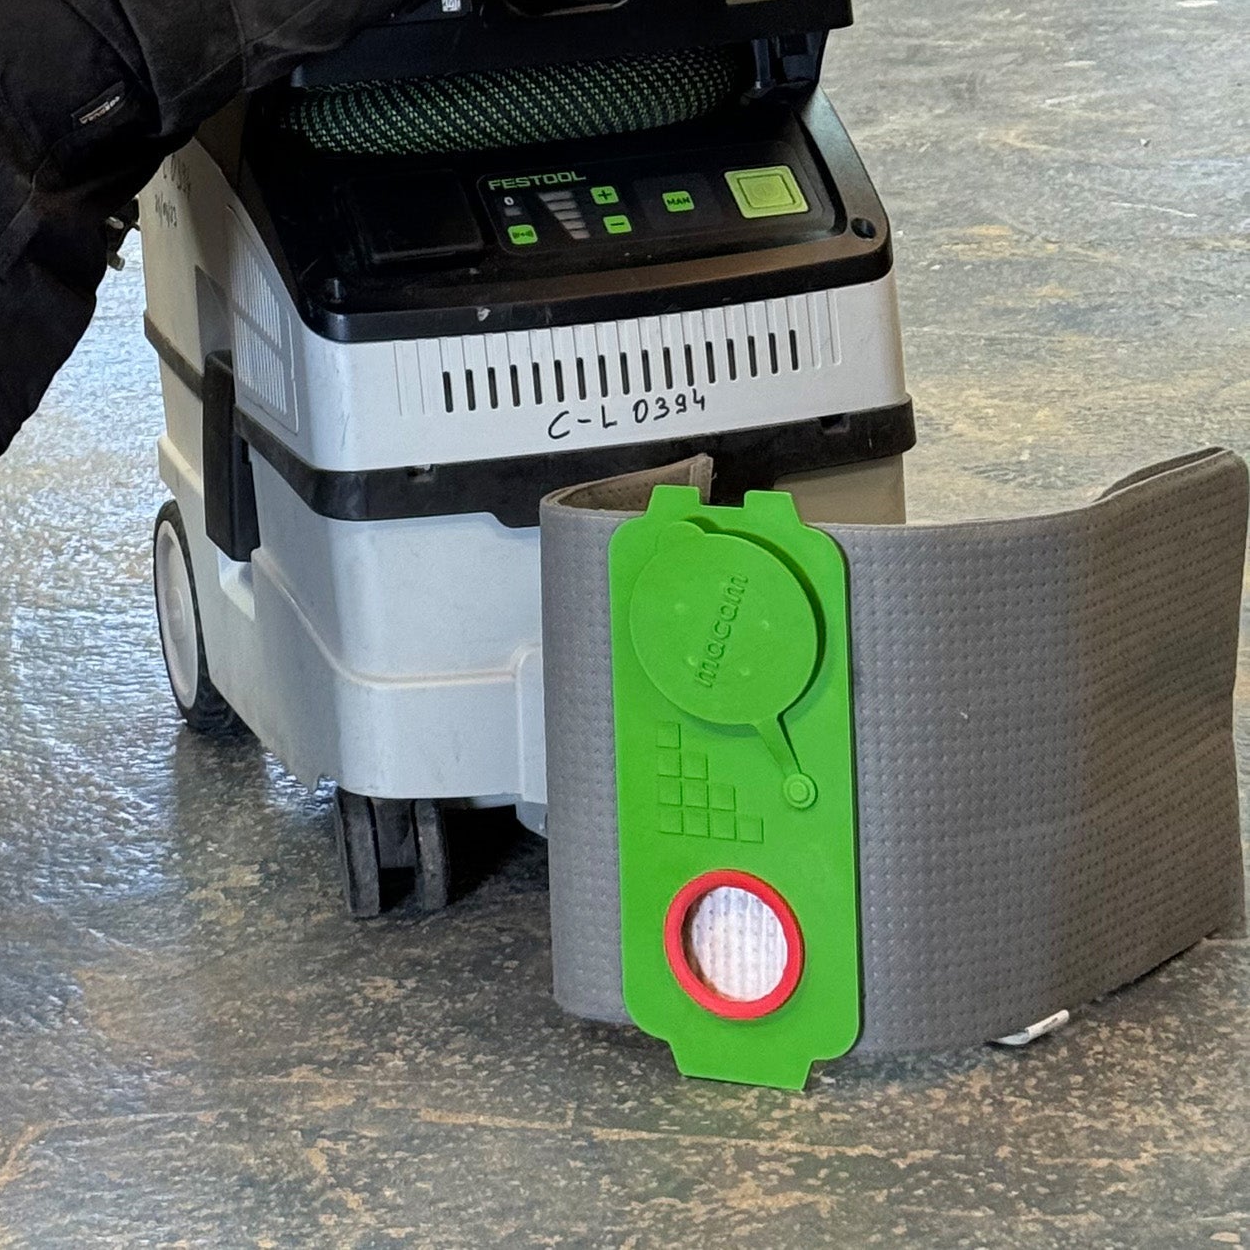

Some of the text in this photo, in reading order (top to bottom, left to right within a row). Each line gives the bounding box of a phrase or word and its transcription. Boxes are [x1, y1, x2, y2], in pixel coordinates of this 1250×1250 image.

[487, 170, 587, 191] FESTOOL
[666, 196, 692, 206] MAN
[632, 388, 706, 424] 0394
